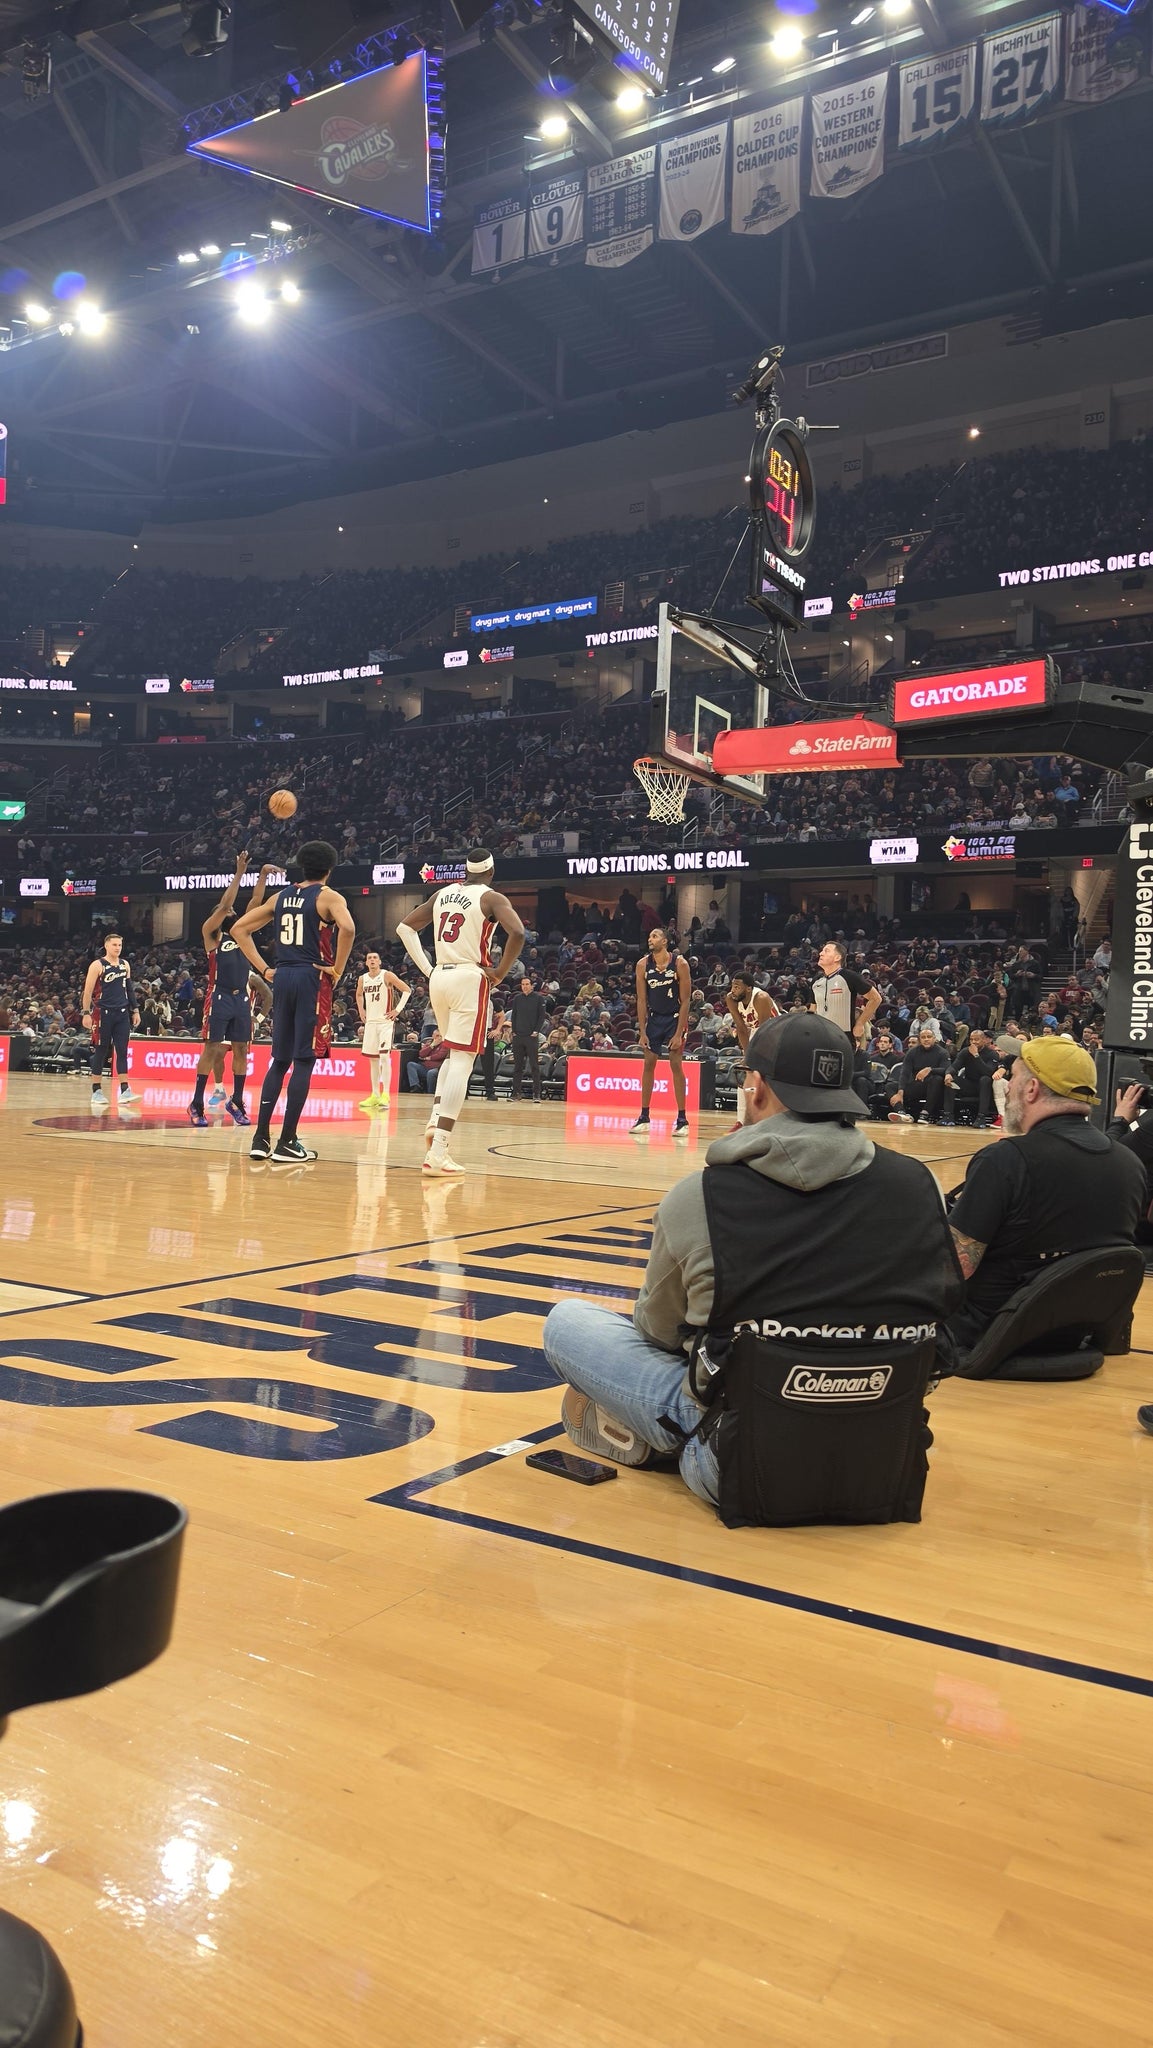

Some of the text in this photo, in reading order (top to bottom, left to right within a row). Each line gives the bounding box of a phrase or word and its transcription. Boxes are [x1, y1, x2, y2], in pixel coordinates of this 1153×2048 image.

[595, 3, 664, 84] CAVS5050.COM
[993, 27, 1050, 56] MICHAYLUK
[906, 54, 969, 84] CALLANDER
[992, 46, 1049, 110] 27
[823, 86, 876, 114] 2015-16
[912, 74, 962, 133] 15
[753, 113, 783, 134] 2016
[824, 105, 875, 132] WESTERN
[736, 125, 800, 158] CALDER CUP
[815, 118, 881, 149] CONFERENCE
[319, 129, 395, 185] CAVALIERS
[665, 142, 722, 171] CHAMPIONS
[668, 134, 720, 158] NORTH DIVISION
[817, 135, 878, 164] CHAMPIONS
[736, 143, 799, 174] CHAMPIONS
[548, 180, 565, 190] FRED
[600, 164, 643, 185] BARONS
[532, 181, 581, 206] GLOVER
[480, 201, 521, 223] BOWER
[546, 205, 564, 246] 9
[492, 223, 504, 263] 1
[596, 242, 626, 257] CALDER
[597, 244, 643, 263] CHAMPIONS
[776, 557, 806, 591] TISSOT
[998, 569, 1031, 587] TWO
[1032, 559, 1105, 582] STATIONS.
[1107, 553, 1137, 571] ONE
[514, 608, 551, 622] drug mart
[555, 601, 593, 616] drug mart
[475, 614, 511, 628] drug mart
[585, 632, 609, 647] TWO
[609, 625, 659, 644] STATIONS.
[29, 679, 49, 690] ONE
[50, 680, 77, 691] GOAL.
[283, 664, 384, 687] TWO STATIONS. ONE GOAL.
[910, 675, 1028, 709] GATORADE
[882, 846, 906, 855] WTAM
[968, 835, 1016, 846] 100.7 FM
[380, 870, 397, 878] WTAM
[567, 850, 750, 875] TWO STATIONS. ONE GOAL.
[165, 876, 187, 890] TWO
[440, 893, 472, 910] ADEBAYO
[280, 913, 304, 946] 31
[437, 911, 466, 943] 13
[1129, 864, 1153, 1041] Cleveland Clinic
[364, 982, 383, 993] HEAT
[371, 993, 381, 1003] 14
[667, 988, 673, 998] 4
[594, 1076, 668, 1093] GATORDE
[763, 1319, 866, 1339] Rocket
[793, 1370, 868, 1393] Coleman
